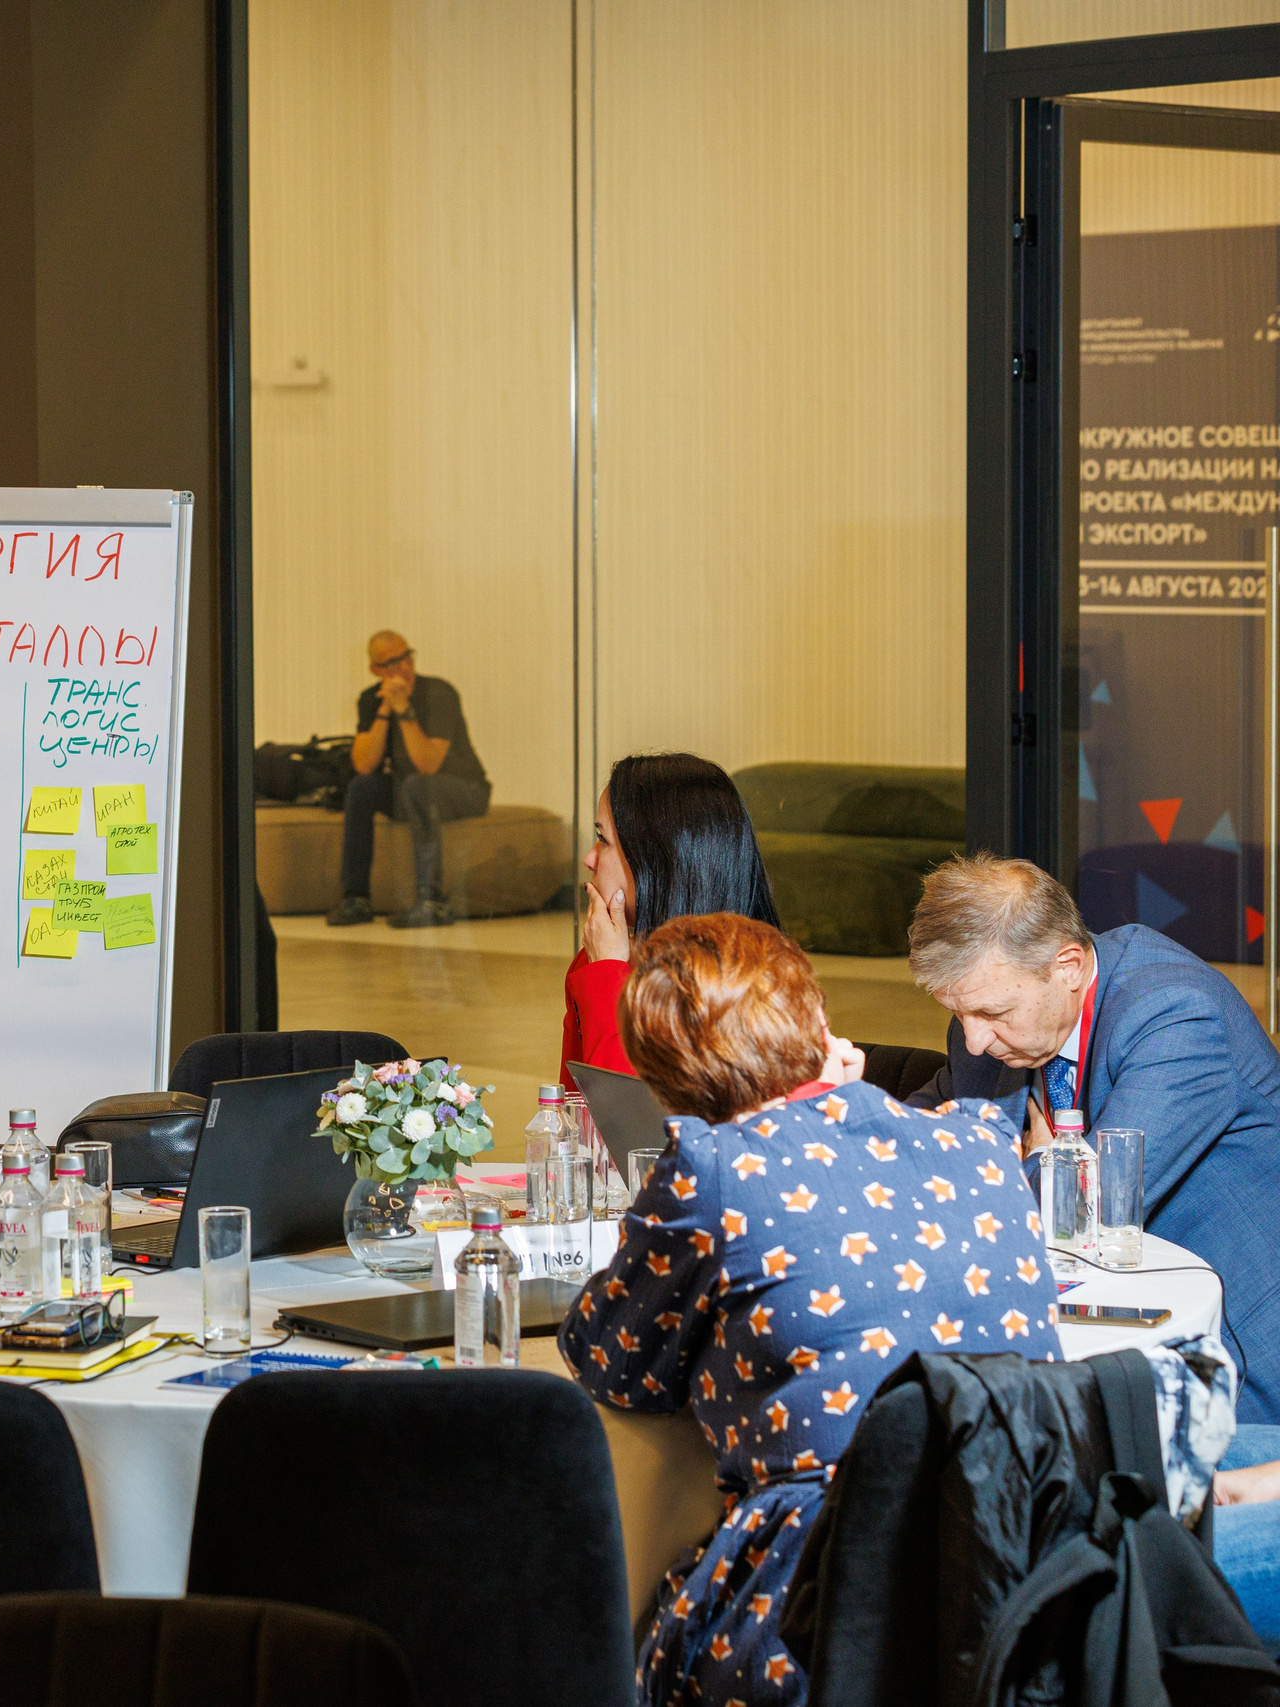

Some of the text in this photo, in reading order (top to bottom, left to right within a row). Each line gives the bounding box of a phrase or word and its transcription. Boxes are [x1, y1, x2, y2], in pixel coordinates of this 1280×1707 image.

[1080, 457, 1280, 484] О РЕАЛИЗАЦИИ Н
[1080, 490, 1167, 514] РОЕКТА
[1125, 574, 1225, 599] АВГУСТА
[33, 787, 79, 818] КИТАЙ
[96, 791, 135, 822] ИРАН
